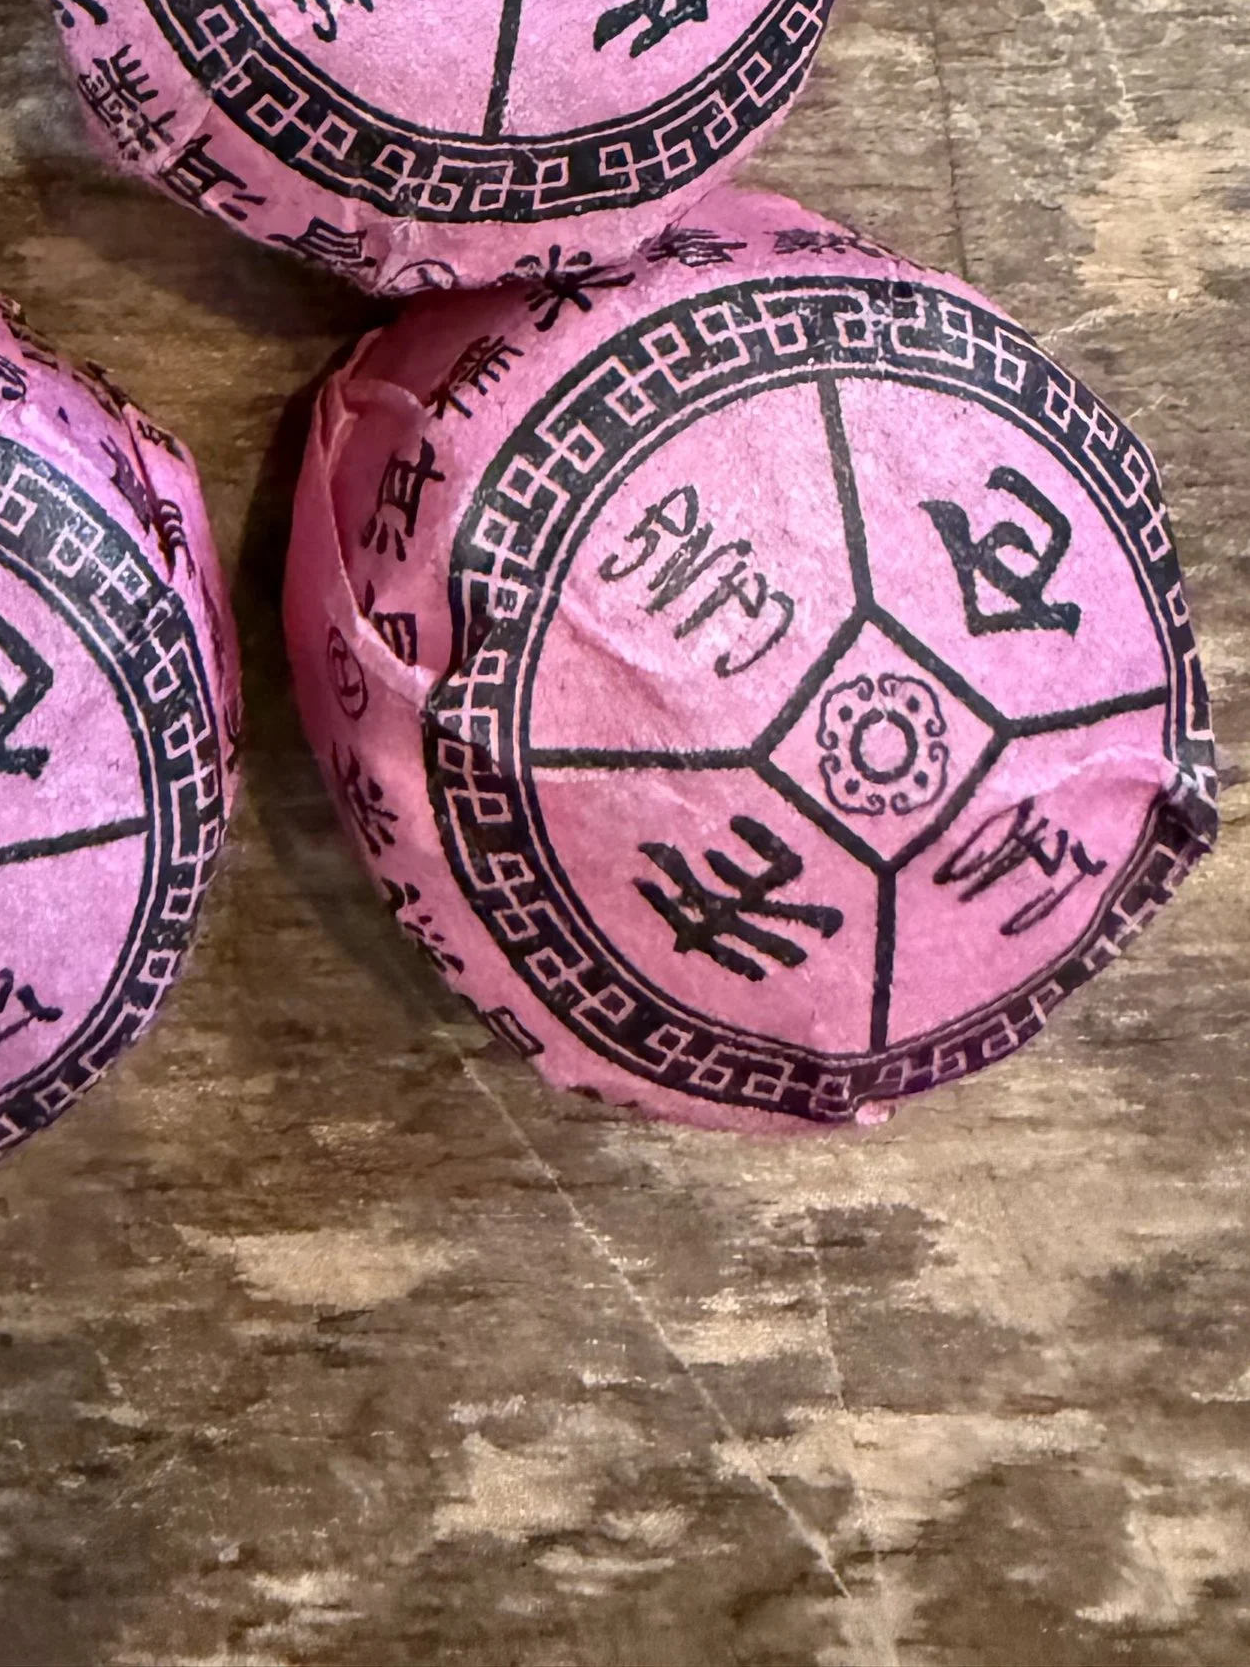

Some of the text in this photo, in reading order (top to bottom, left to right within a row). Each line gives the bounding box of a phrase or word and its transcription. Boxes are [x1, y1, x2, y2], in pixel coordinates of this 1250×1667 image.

[598, 483, 797, 678] CANG
[918, 465, 1082, 639] 仓
[633, 815, 845, 983] 老
[934, 795, 1108, 936] LAO
